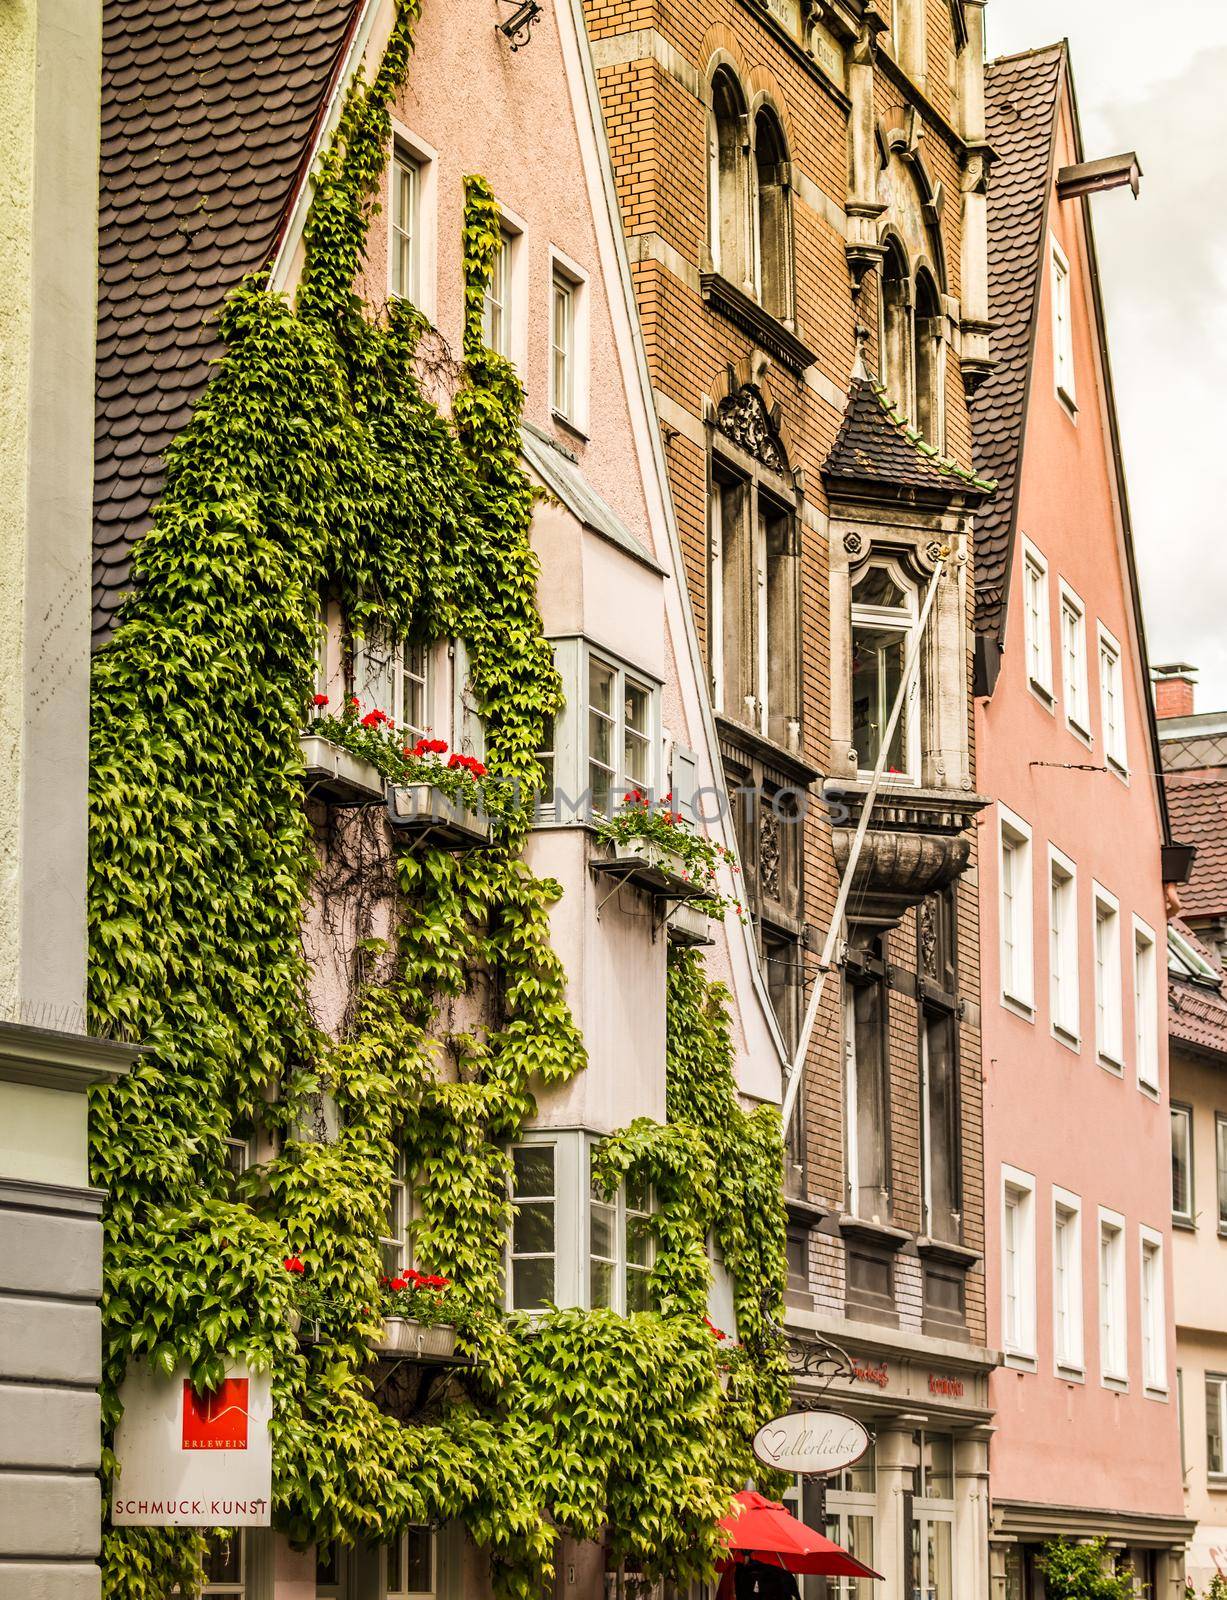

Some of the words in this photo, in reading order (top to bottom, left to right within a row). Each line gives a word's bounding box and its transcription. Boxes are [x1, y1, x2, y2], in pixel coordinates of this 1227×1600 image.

[184, 1440, 246, 1448] ERLEWEIN
[781, 1428, 857, 1457] allerliebst
[211, 1500, 267, 1514] KUNST
